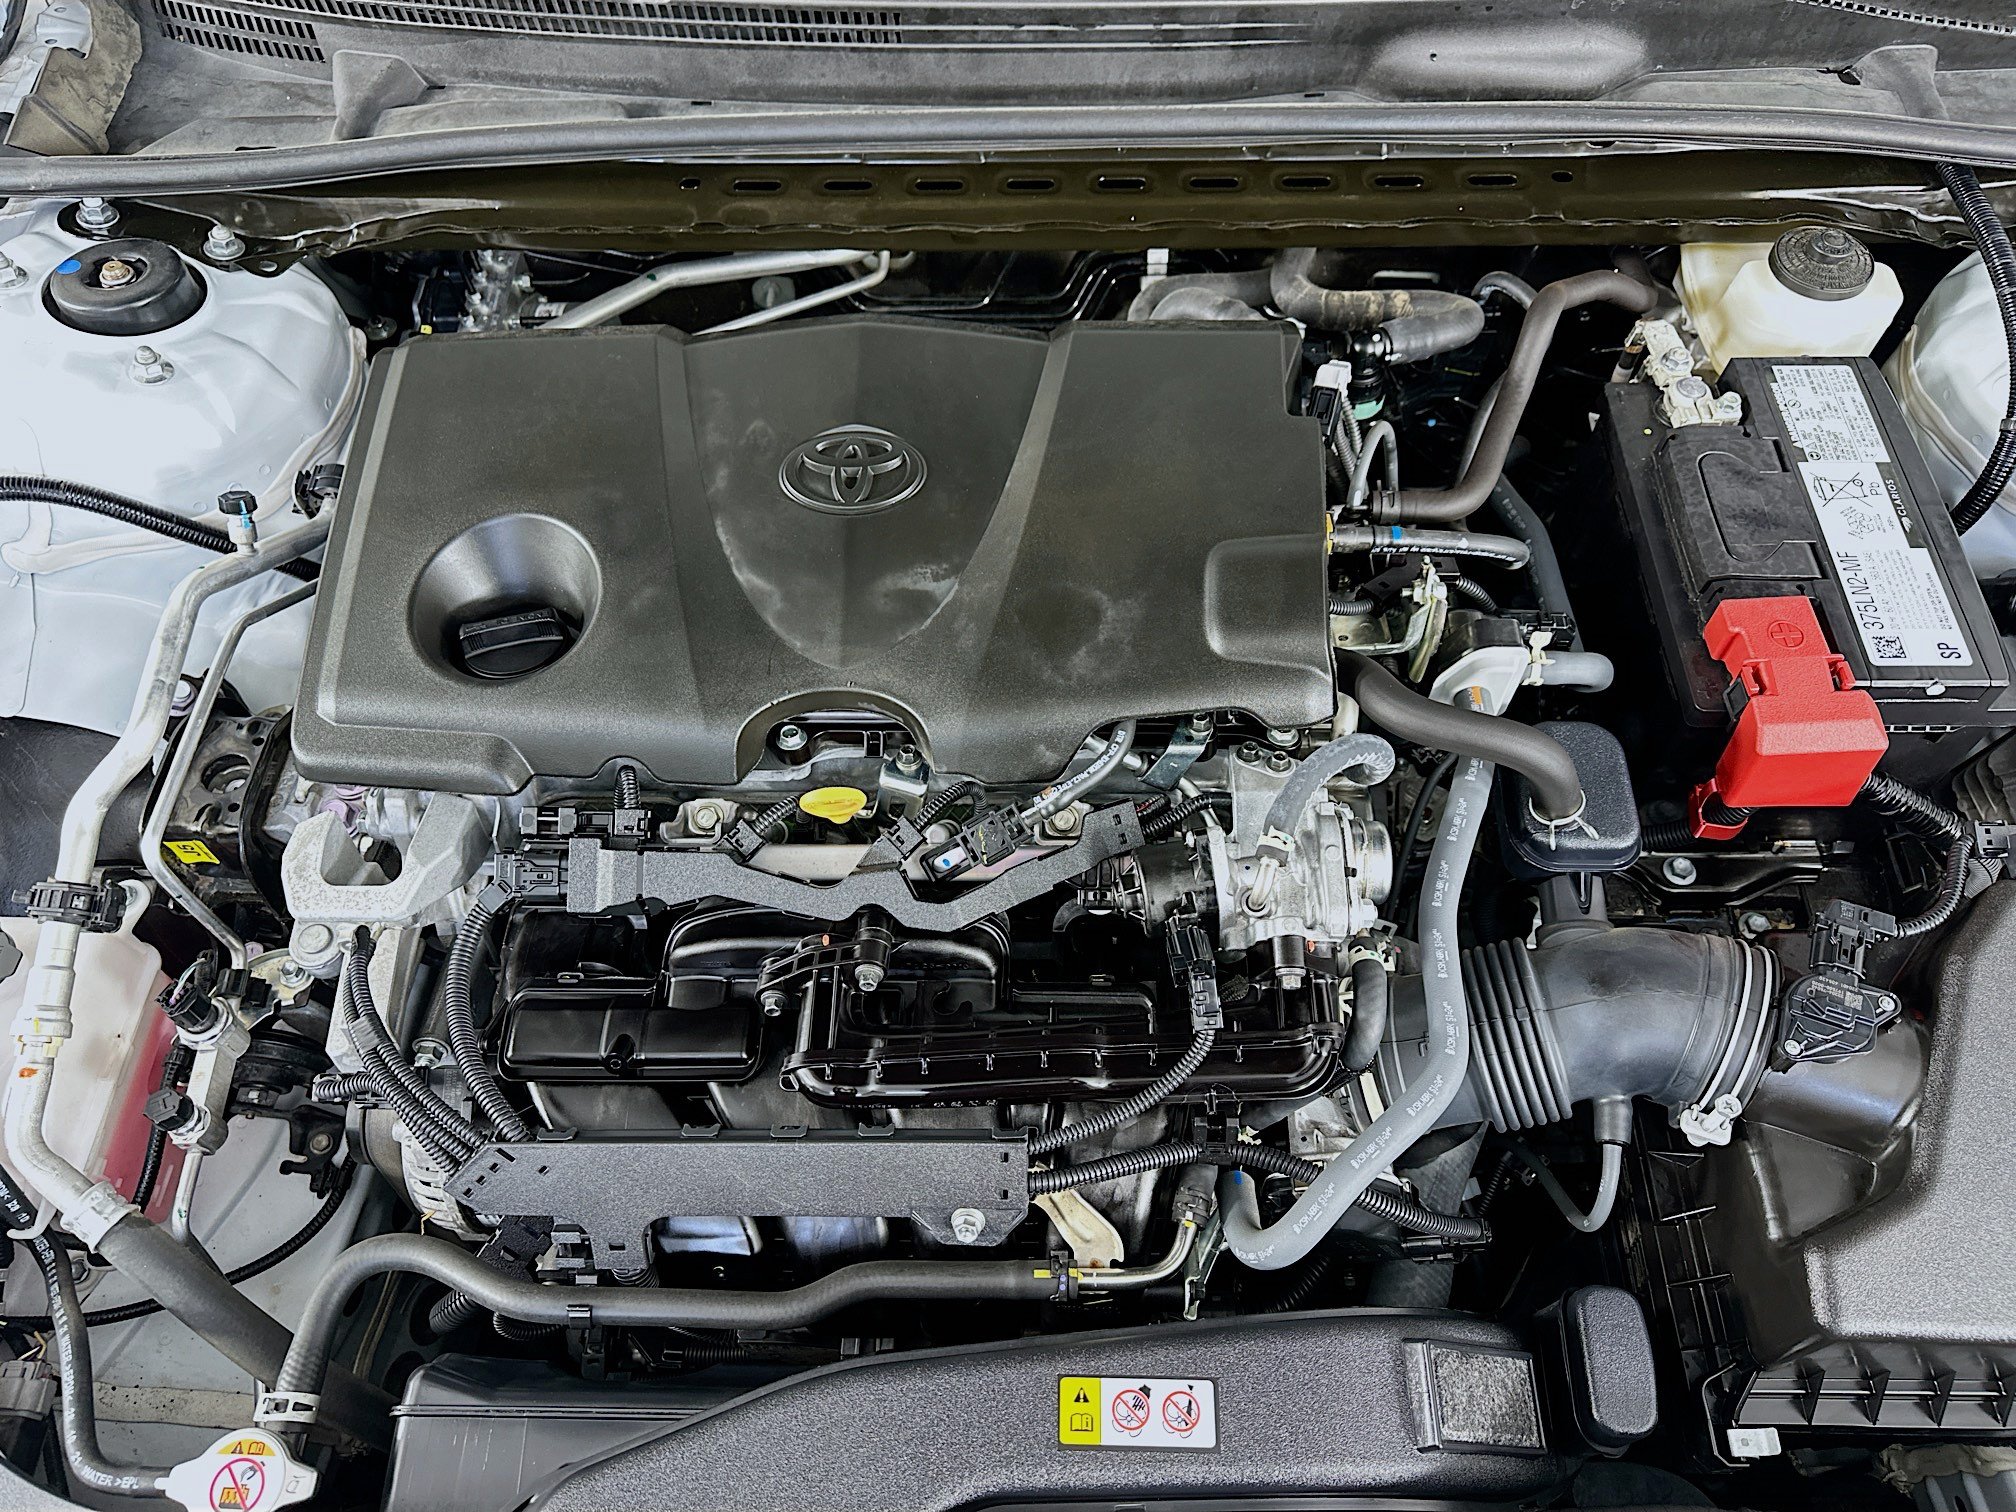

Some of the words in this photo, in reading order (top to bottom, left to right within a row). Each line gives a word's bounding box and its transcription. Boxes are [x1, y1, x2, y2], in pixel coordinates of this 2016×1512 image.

[1869, 482, 1882, 497] Pb
[1886, 479, 1907, 516] CLARIOS
[1836, 551, 1884, 630] 375LN2-MF
[1940, 642, 1961, 660] SP
[61, 1334, 73, 1364] WATER
[81, 1465, 114, 1488] WATER
